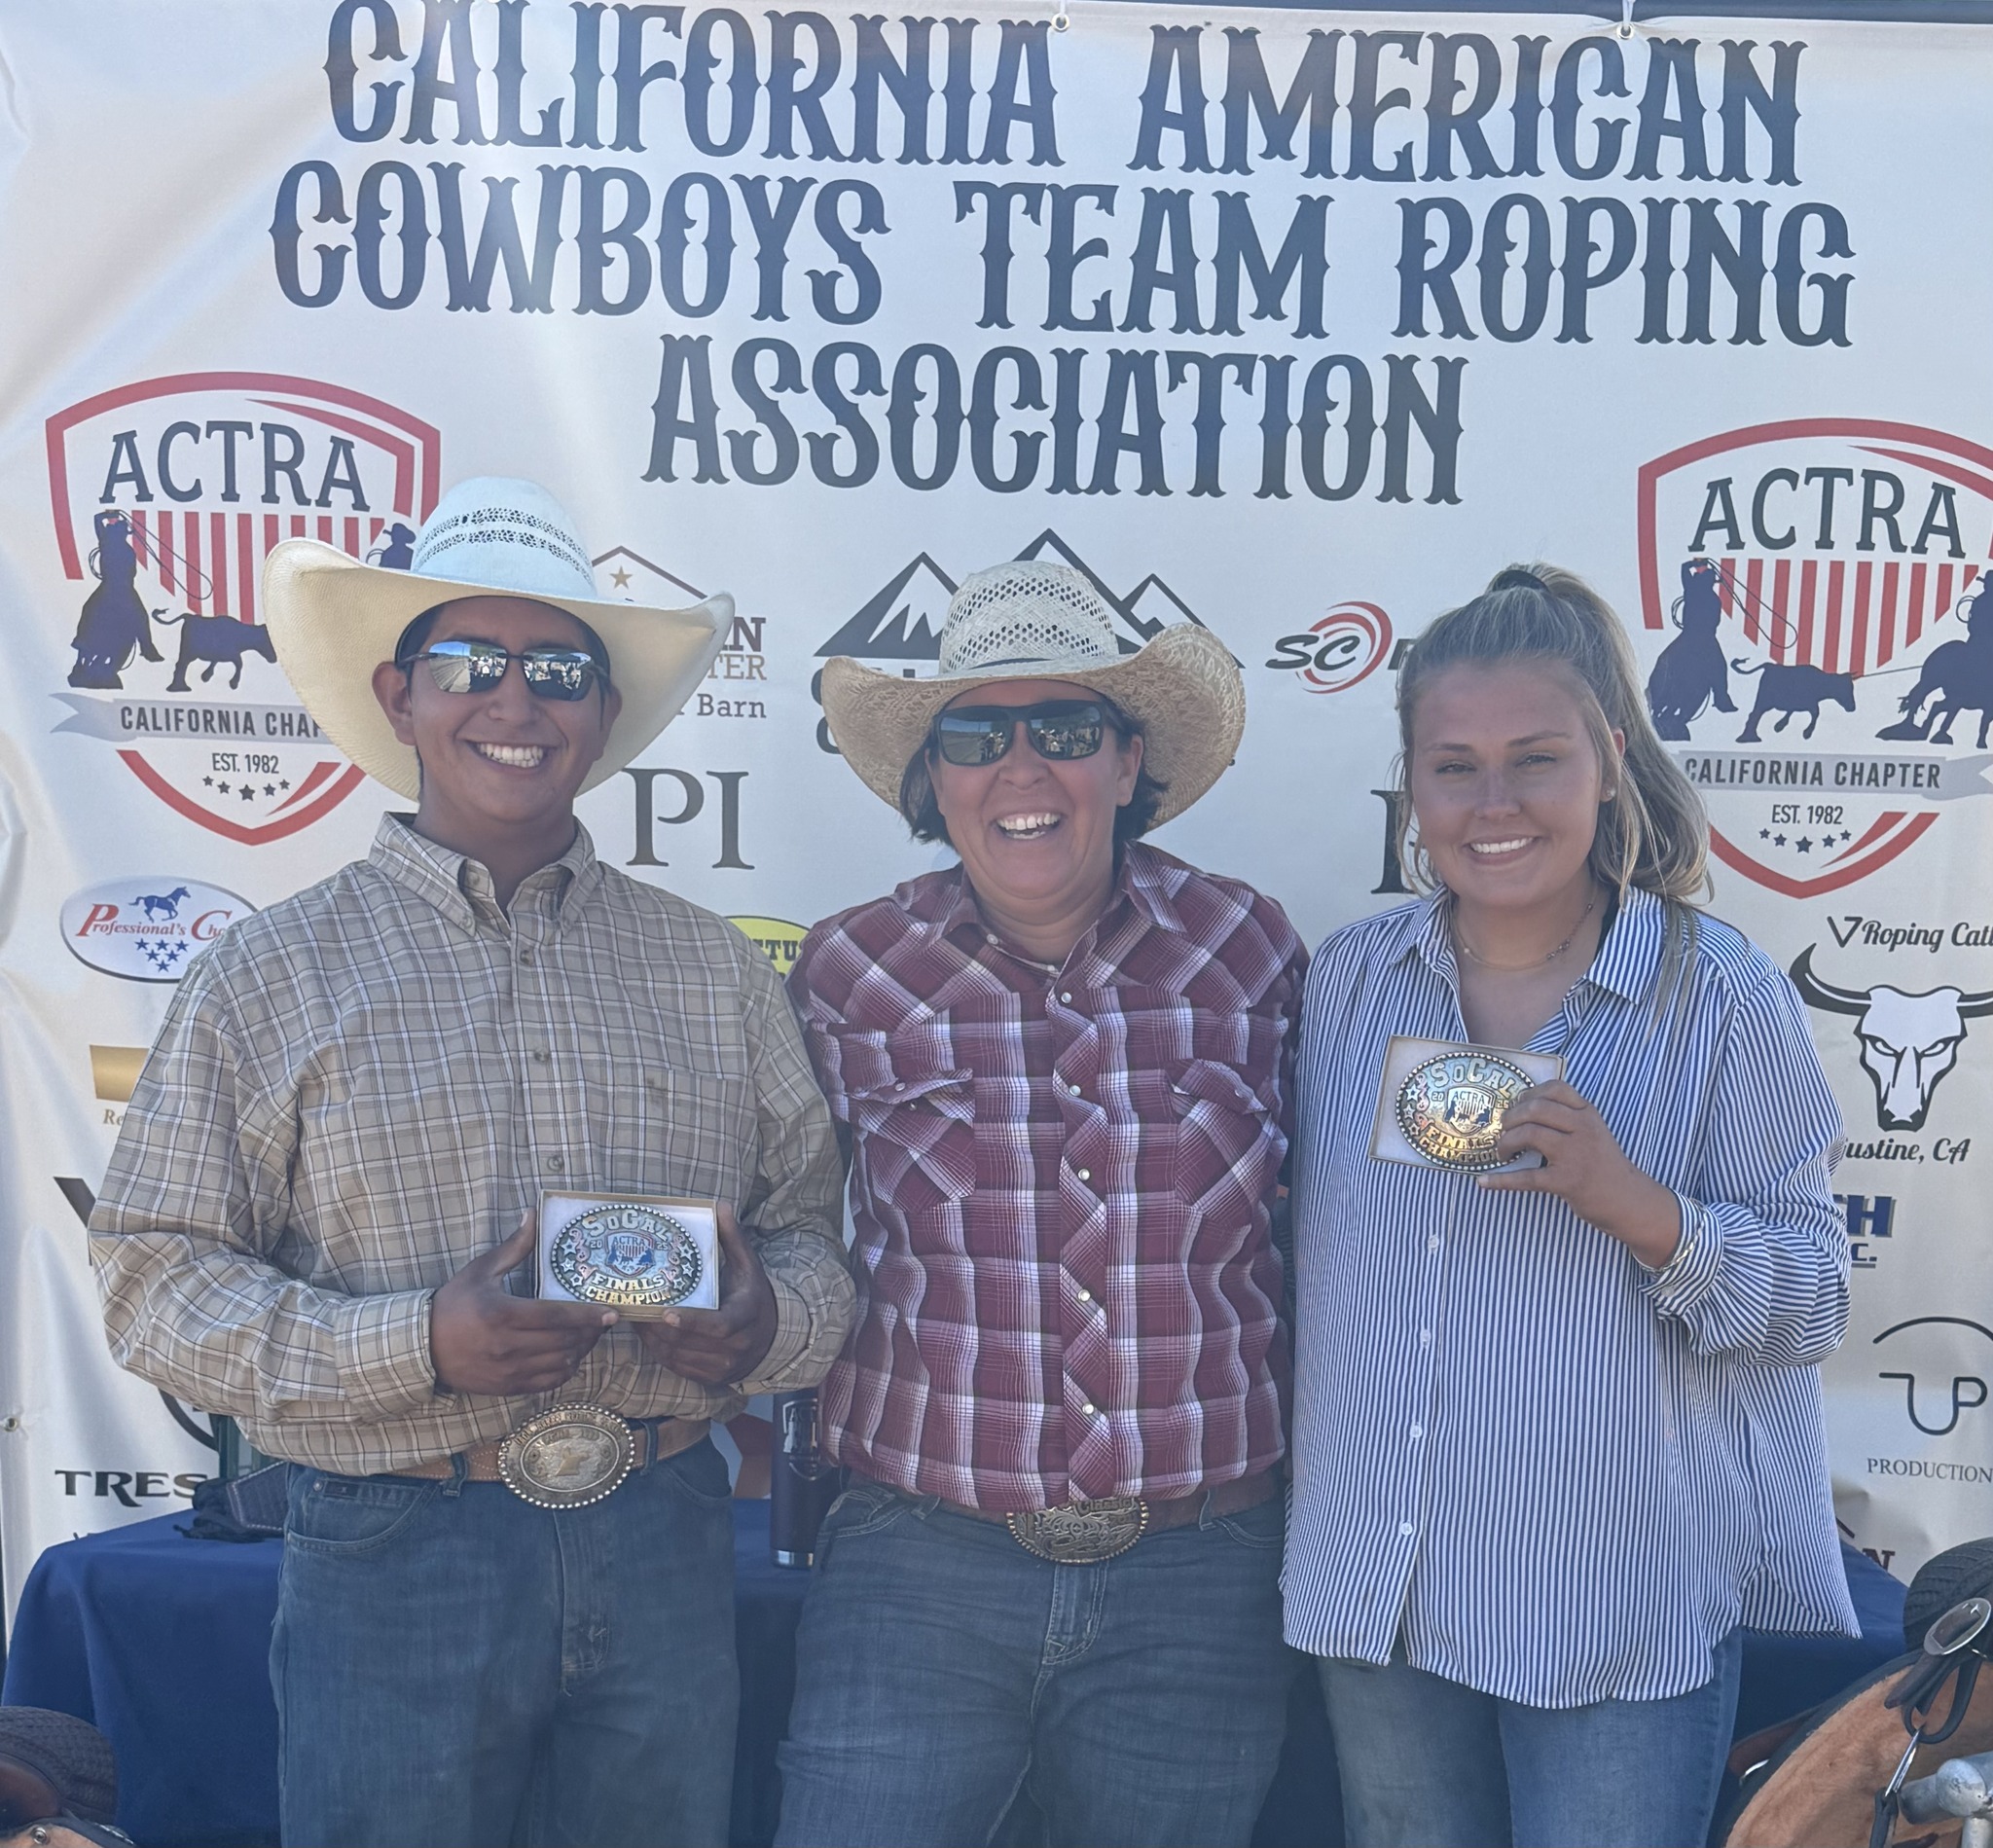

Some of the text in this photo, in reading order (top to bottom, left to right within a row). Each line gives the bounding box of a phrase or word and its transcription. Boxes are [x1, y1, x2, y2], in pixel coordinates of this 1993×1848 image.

[323, 0, 1809, 186] CALIFORNIA AMERICAN
[270, 161, 1856, 347] COWBOYS TEAM ROPING
[641, 334, 1468, 505] ASSOCIATION
[99, 420, 370, 512] ACTRA
[1687, 467, 1966, 559] ACTRA
[697, 693, 767, 718] Barn
[121, 706, 255, 737] CALIFORNIA
[212, 753, 279, 774] EST. 1982
[1685, 758, 1940, 788] CALIFORNIA CHAPTER
[1772, 805, 1843, 824] EST. 1982
[76, 903, 187, 937] Professional's
[1862, 920, 1944, 953] Roping
[1844, 1138, 1971, 1165] ustine, CA
[612, 1235, 646, 1246] ACTRA
[586, 1286, 671, 1304] CHAMPION
[593, 1273, 666, 1291] FINALS
[54, 1469, 207, 1507] TRES
